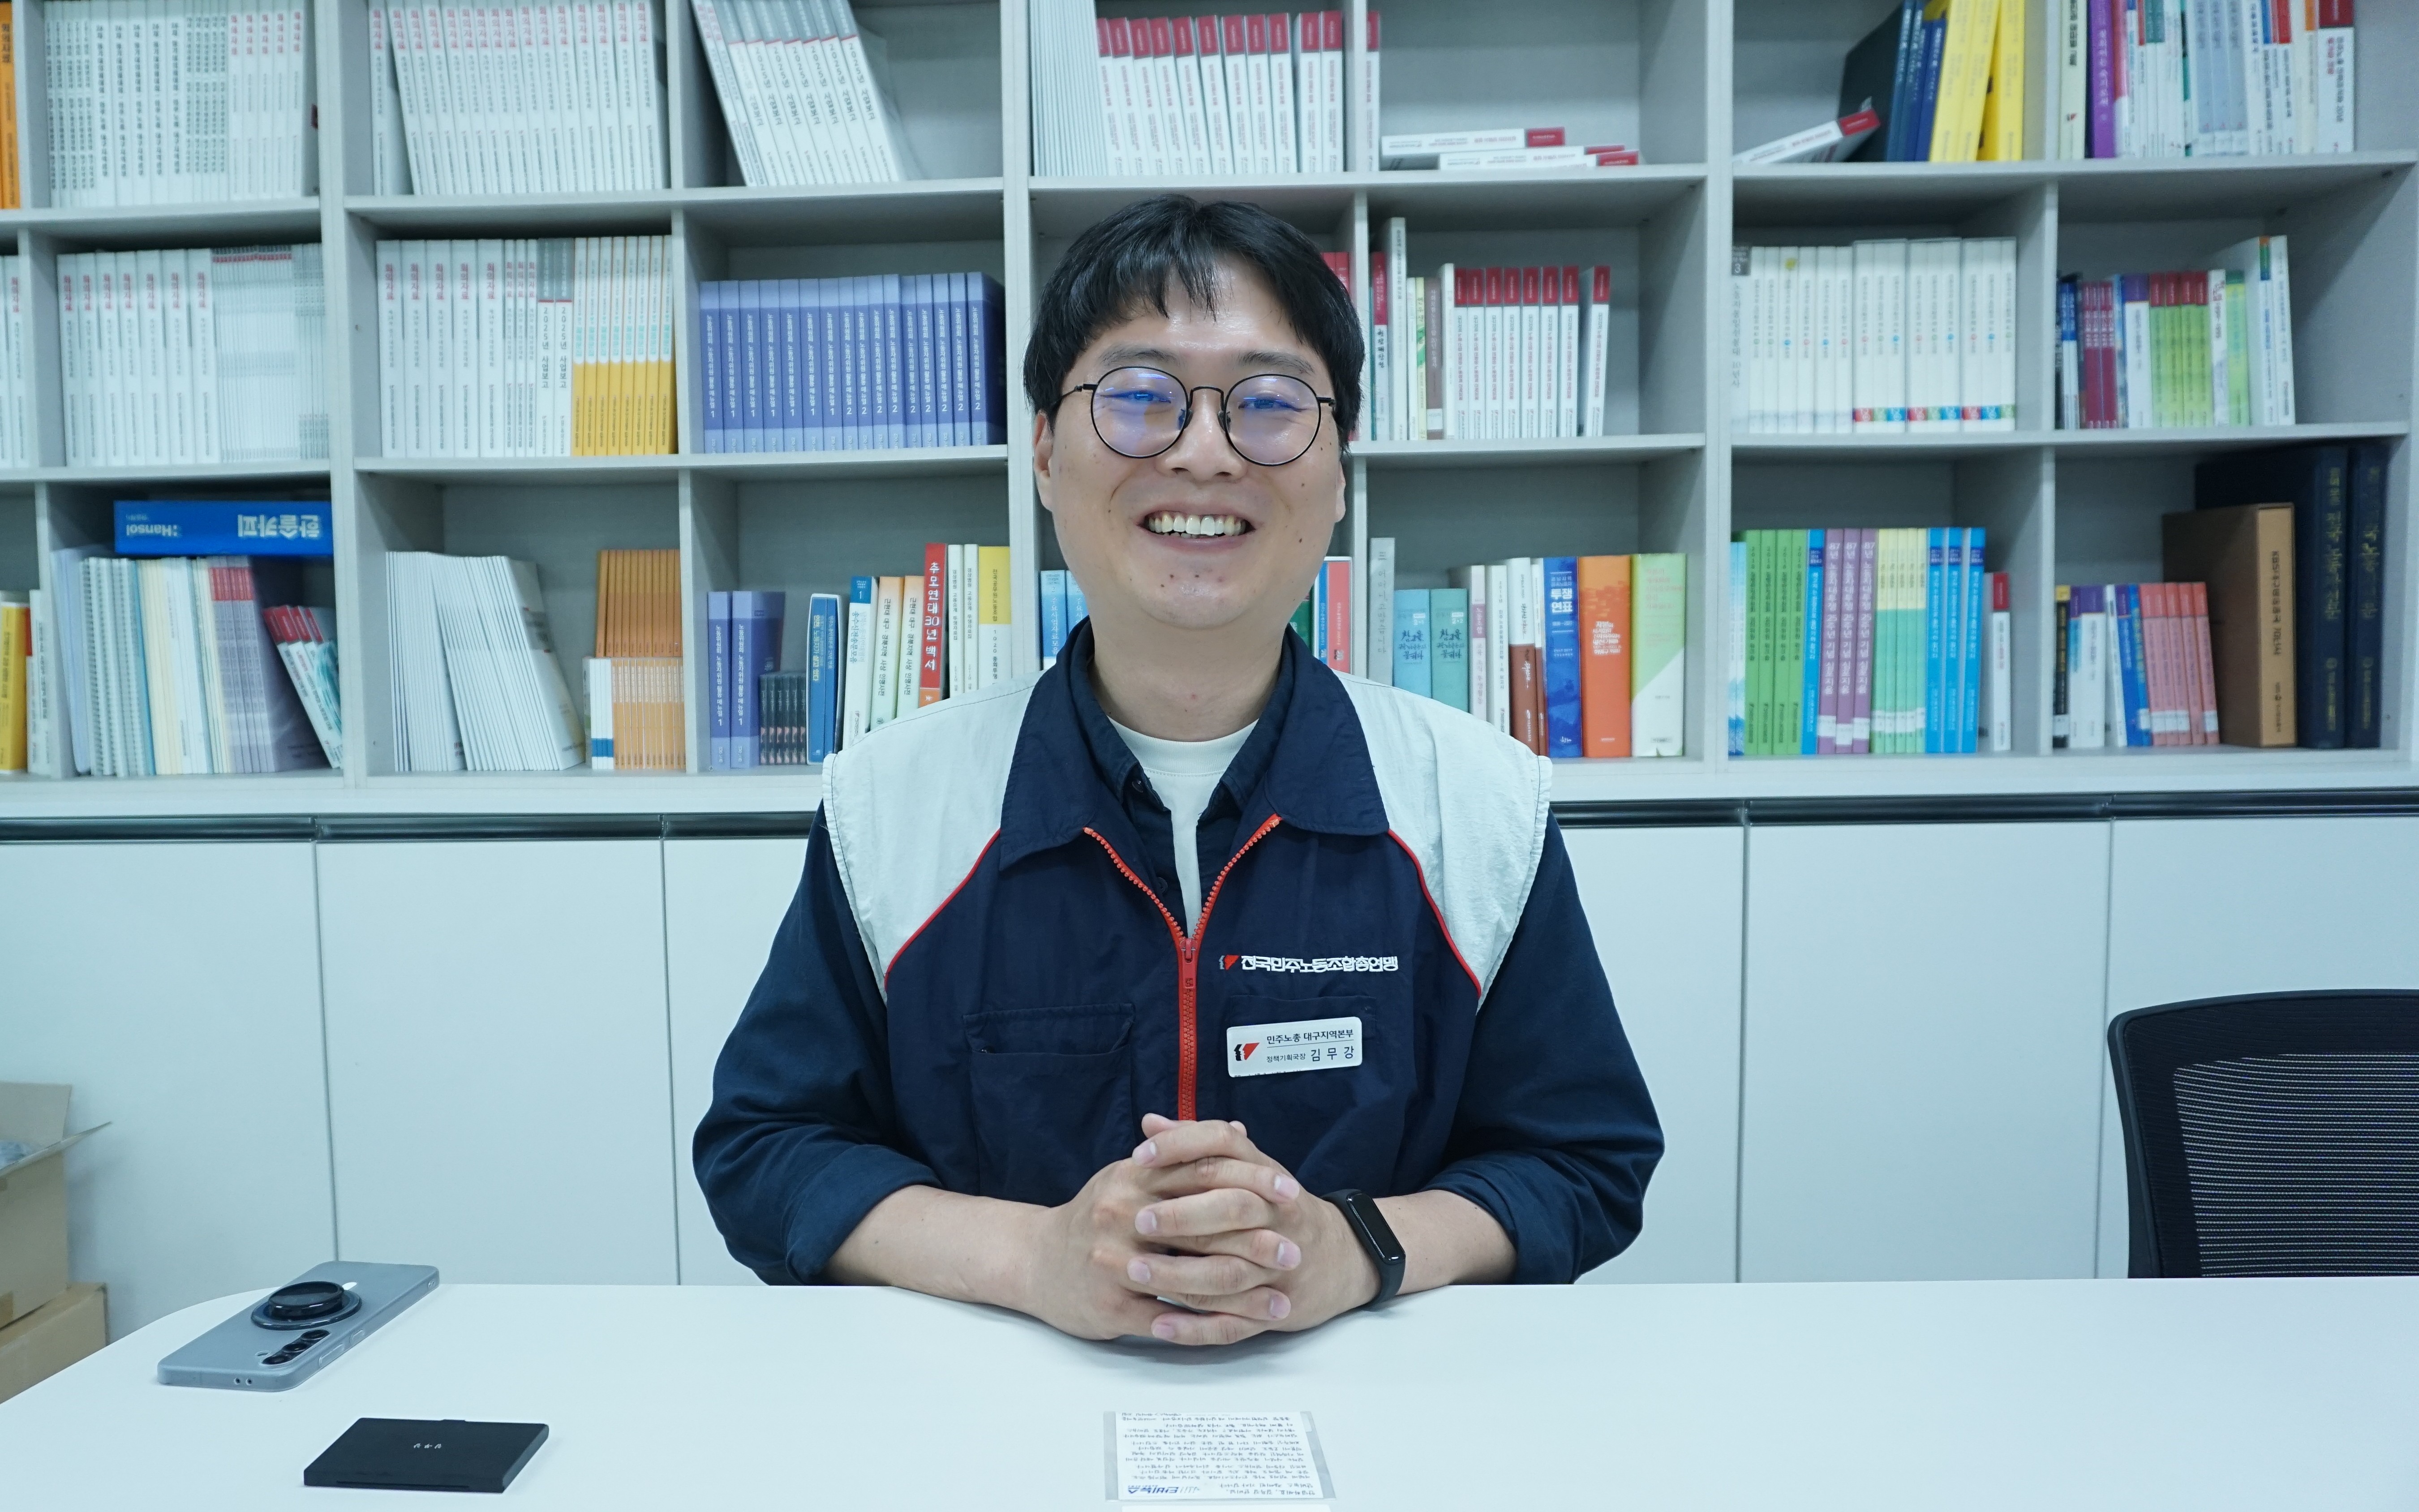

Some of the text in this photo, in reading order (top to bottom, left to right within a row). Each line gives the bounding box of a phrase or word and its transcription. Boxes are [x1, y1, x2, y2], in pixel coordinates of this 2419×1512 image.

[126, 524, 172, 536] Hansol
[237, 514, 320, 538] 한솔카피
[1829, 543, 1840, 559] 87년
[1846, 542, 1857, 559] 87년
[1864, 542, 1875, 558] 87년
[859, 591, 862, 599] 1
[1551, 588, 1572, 599] 투쟁
[1551, 601, 1573, 613] 연표
[1051, 598, 1059, 654] 주요사업자료모음
[812, 655, 820, 667] 살고
[905, 659, 912, 670] 사상
[924, 646, 937, 670] 백서
[880, 660, 886, 671] 사상
[812, 669, 820, 681] 있다
[878, 674, 886, 696] 인명사전
[1241, 956, 1398, 973] 전국민주노동조합총연맹
[1267, 1029, 1354, 1044] 민주노총 대구지역본부
[1266, 1052, 1306, 1063] 정책기획국장
